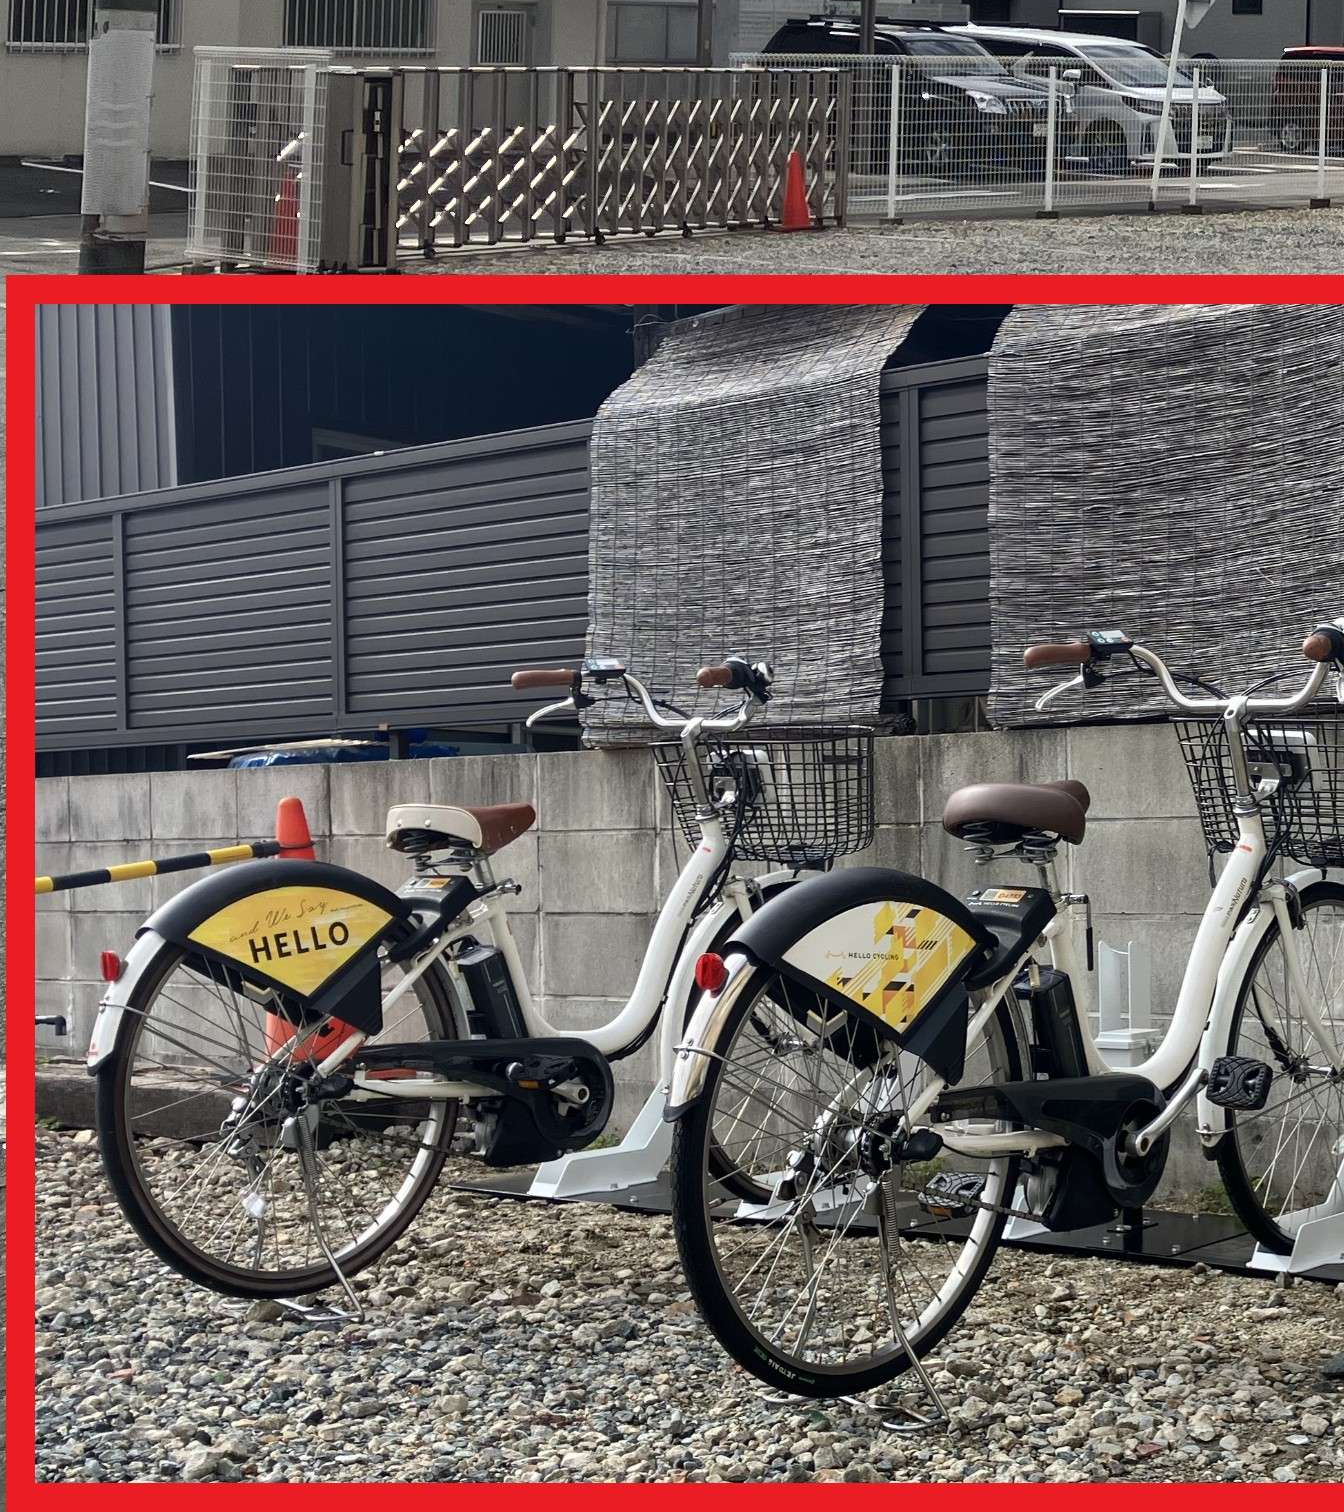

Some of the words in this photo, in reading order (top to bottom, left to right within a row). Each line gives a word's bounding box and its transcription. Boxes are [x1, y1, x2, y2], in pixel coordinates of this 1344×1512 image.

[229, 921, 260, 943] and
[265, 907, 291, 928] We
[248, 921, 349, 963] HELLO
